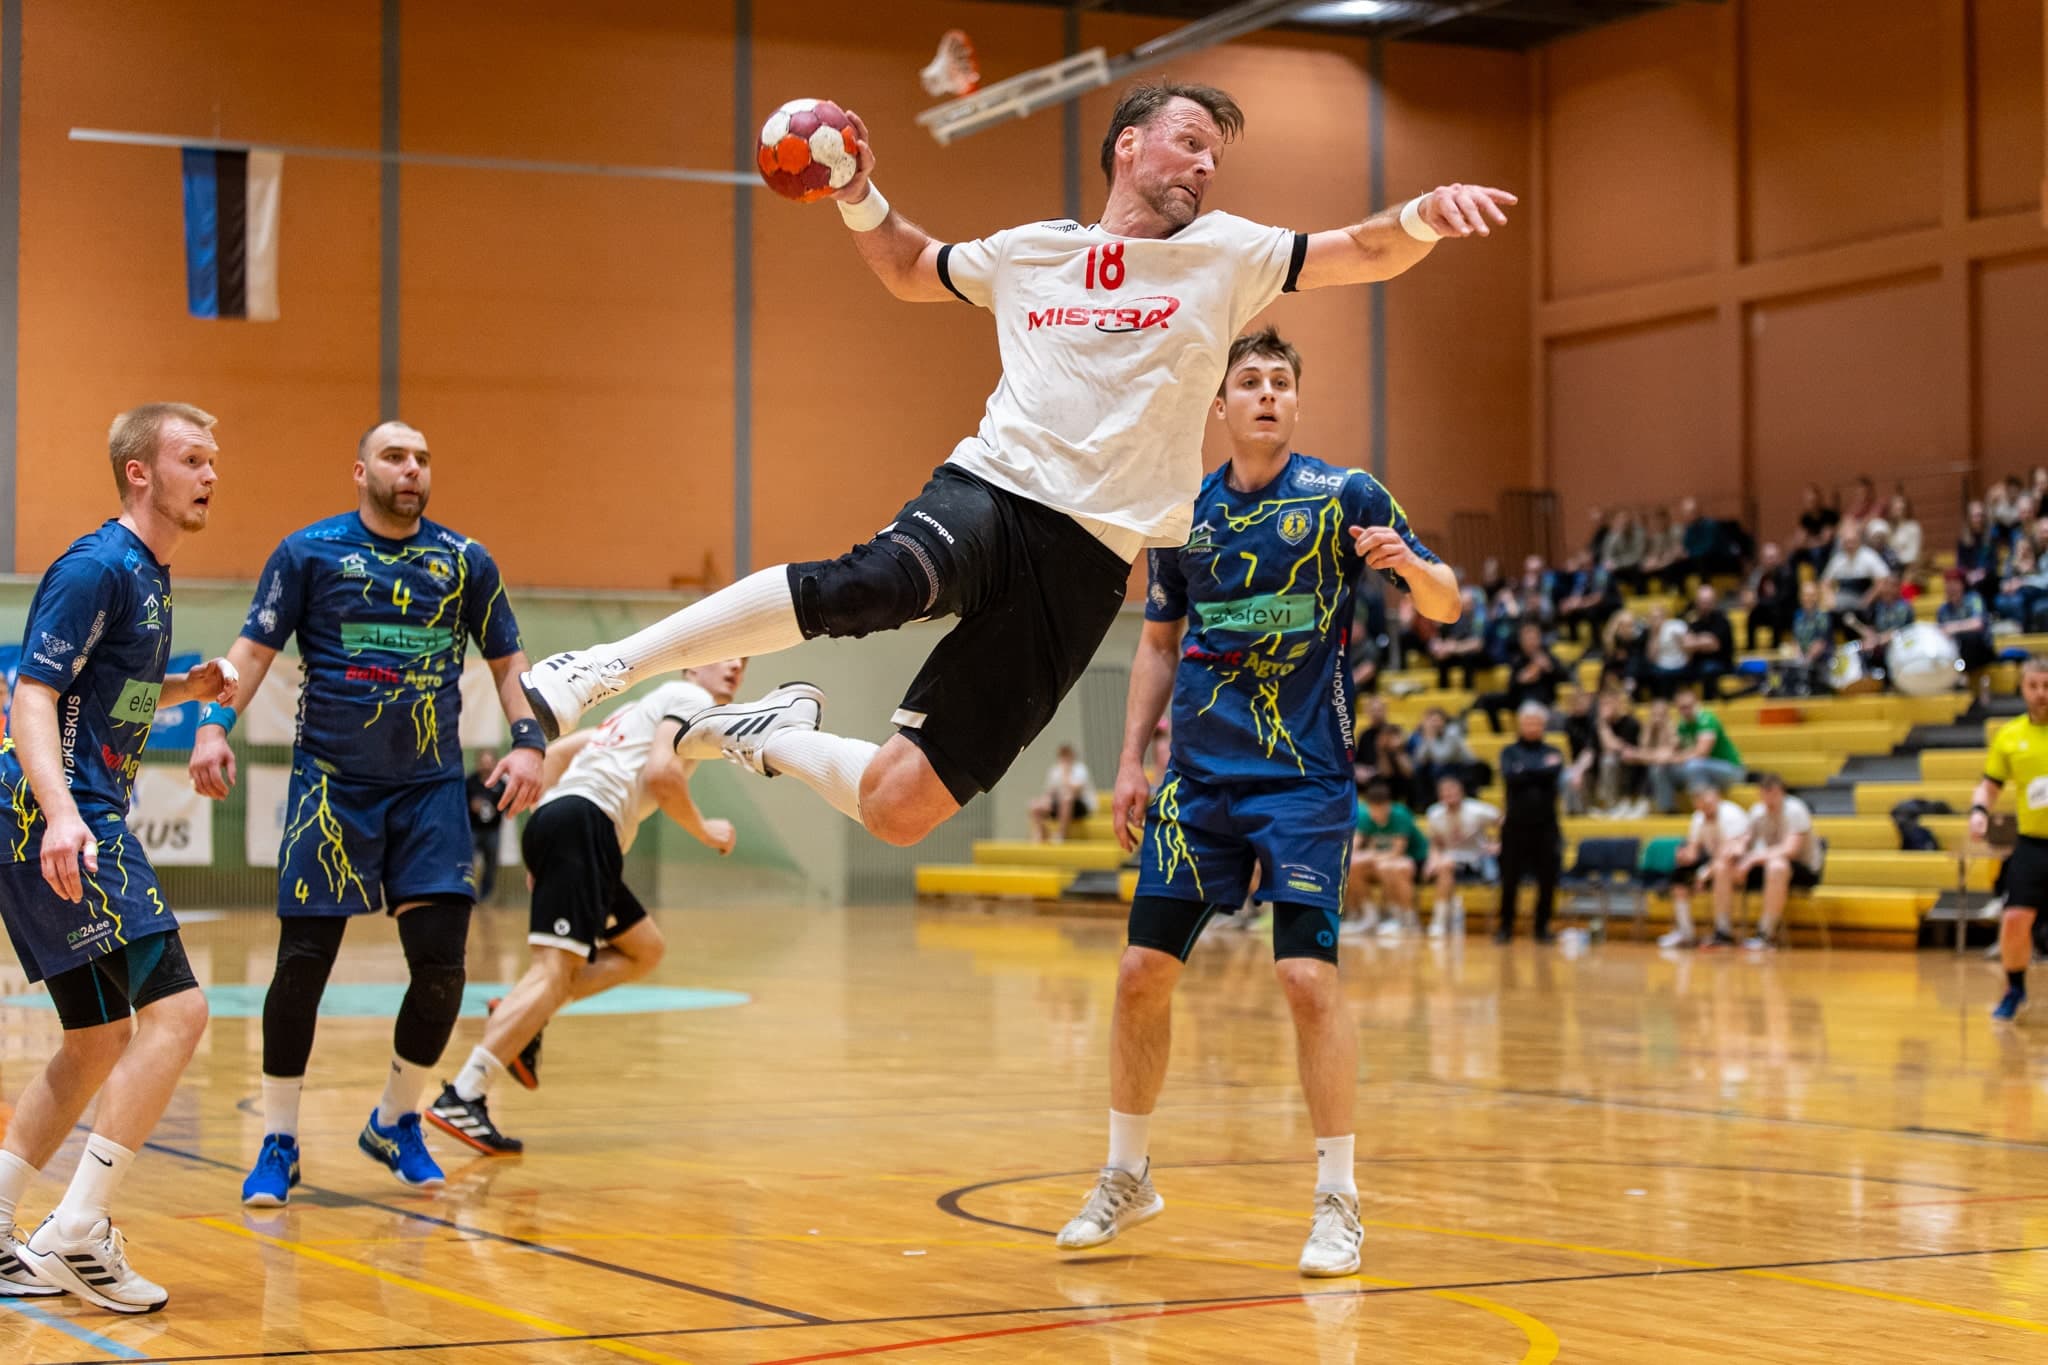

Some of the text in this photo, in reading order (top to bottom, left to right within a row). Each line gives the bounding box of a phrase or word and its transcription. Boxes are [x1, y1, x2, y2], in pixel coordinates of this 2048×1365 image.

[1085, 241, 1125, 290] 18
[1028, 307, 1169, 331] MISTRA
[1299, 470, 1344, 487] DAG
[912, 510, 955, 545] Kempa
[1240, 551, 1257, 588] 7
[392, 579, 412, 615] 4
[33, 652, 64, 671] Viljandi
[1243, 651, 1295, 678] Agro
[404, 670, 442, 690] Agro
[62, 695, 81, 789] UTOKESKUS
[146, 887, 164, 915] 3
[295, 878, 309, 904] 4
